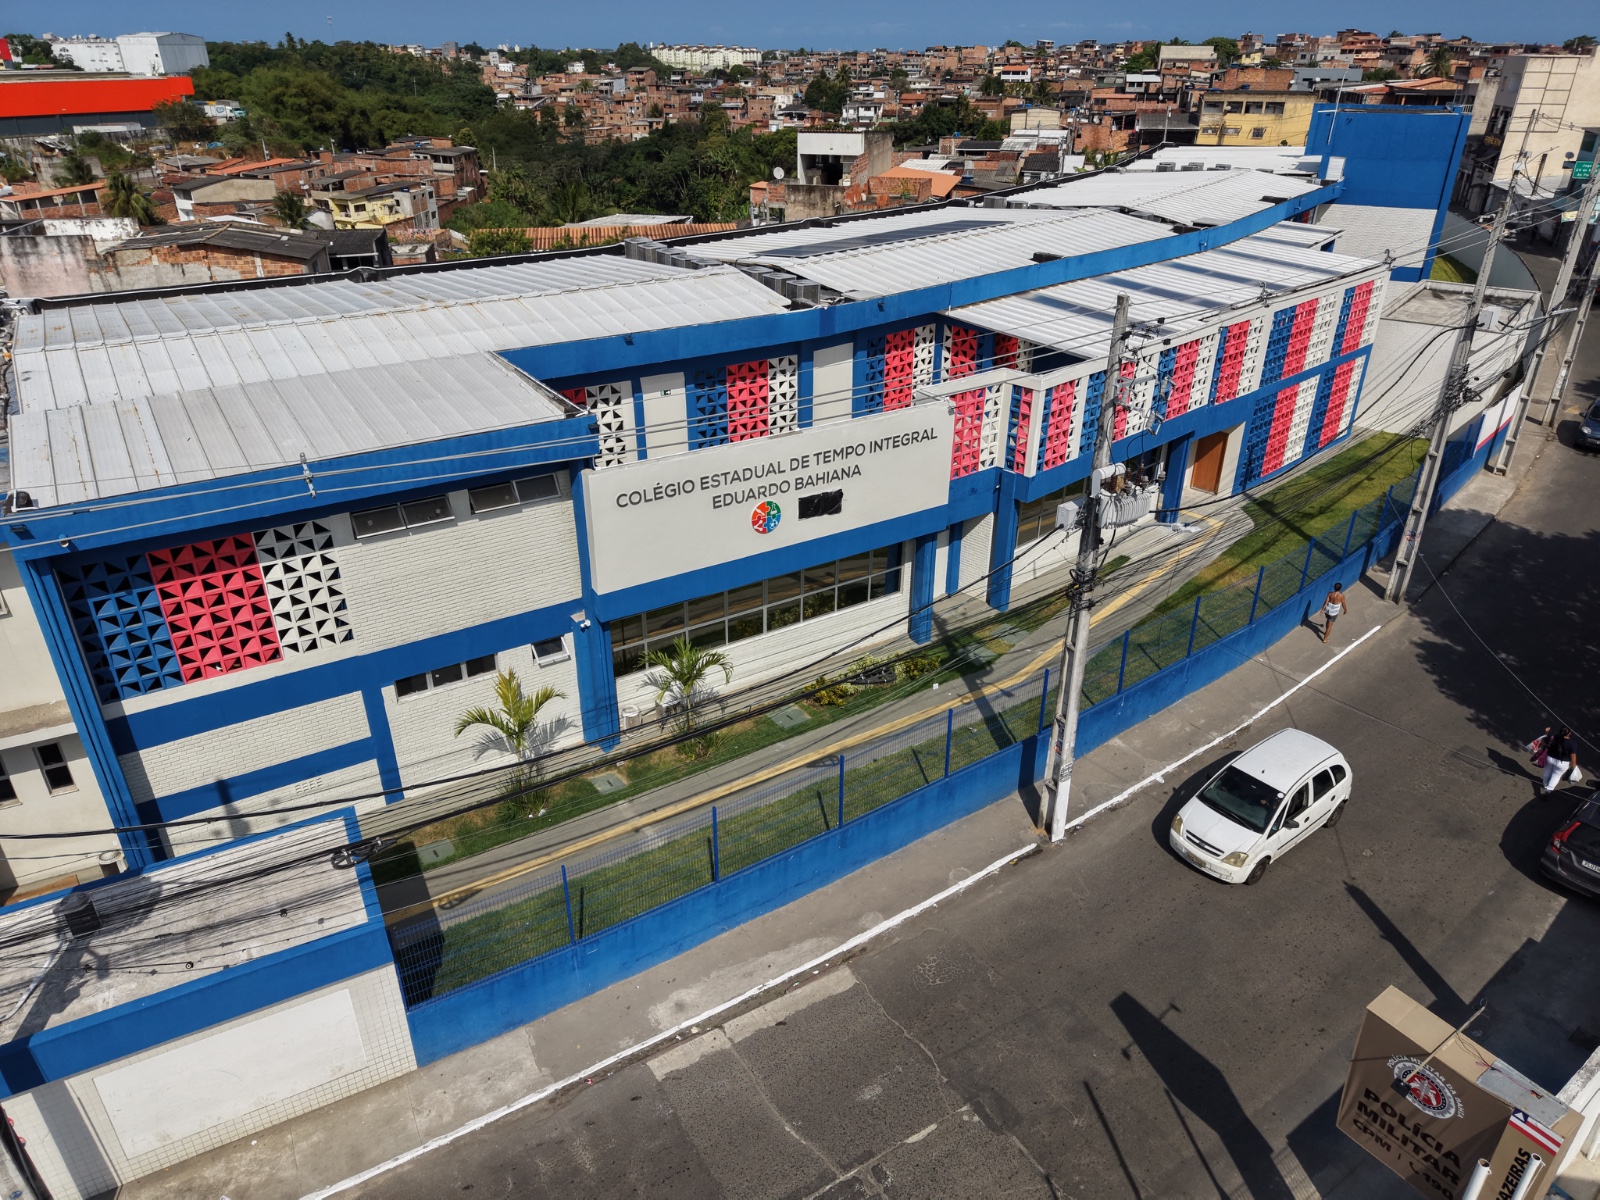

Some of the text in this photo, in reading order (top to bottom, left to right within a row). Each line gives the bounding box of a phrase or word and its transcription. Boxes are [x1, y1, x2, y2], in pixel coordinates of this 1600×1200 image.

[616, 427, 938, 508] COLÉGIO ESTADUAL DE TEMPO INTEGRAL
[712, 464, 862, 510] EDUARDO BAHIANA
[1363, 1087, 1461, 1170] POLÍCIA
[1446, 1083, 1457, 1095] DA
[1353, 1118, 1455, 1200] CPM 190
[1357, 1100, 1461, 1187] MILITAR
[1495, 1147, 1532, 1200] AZEIRAS
